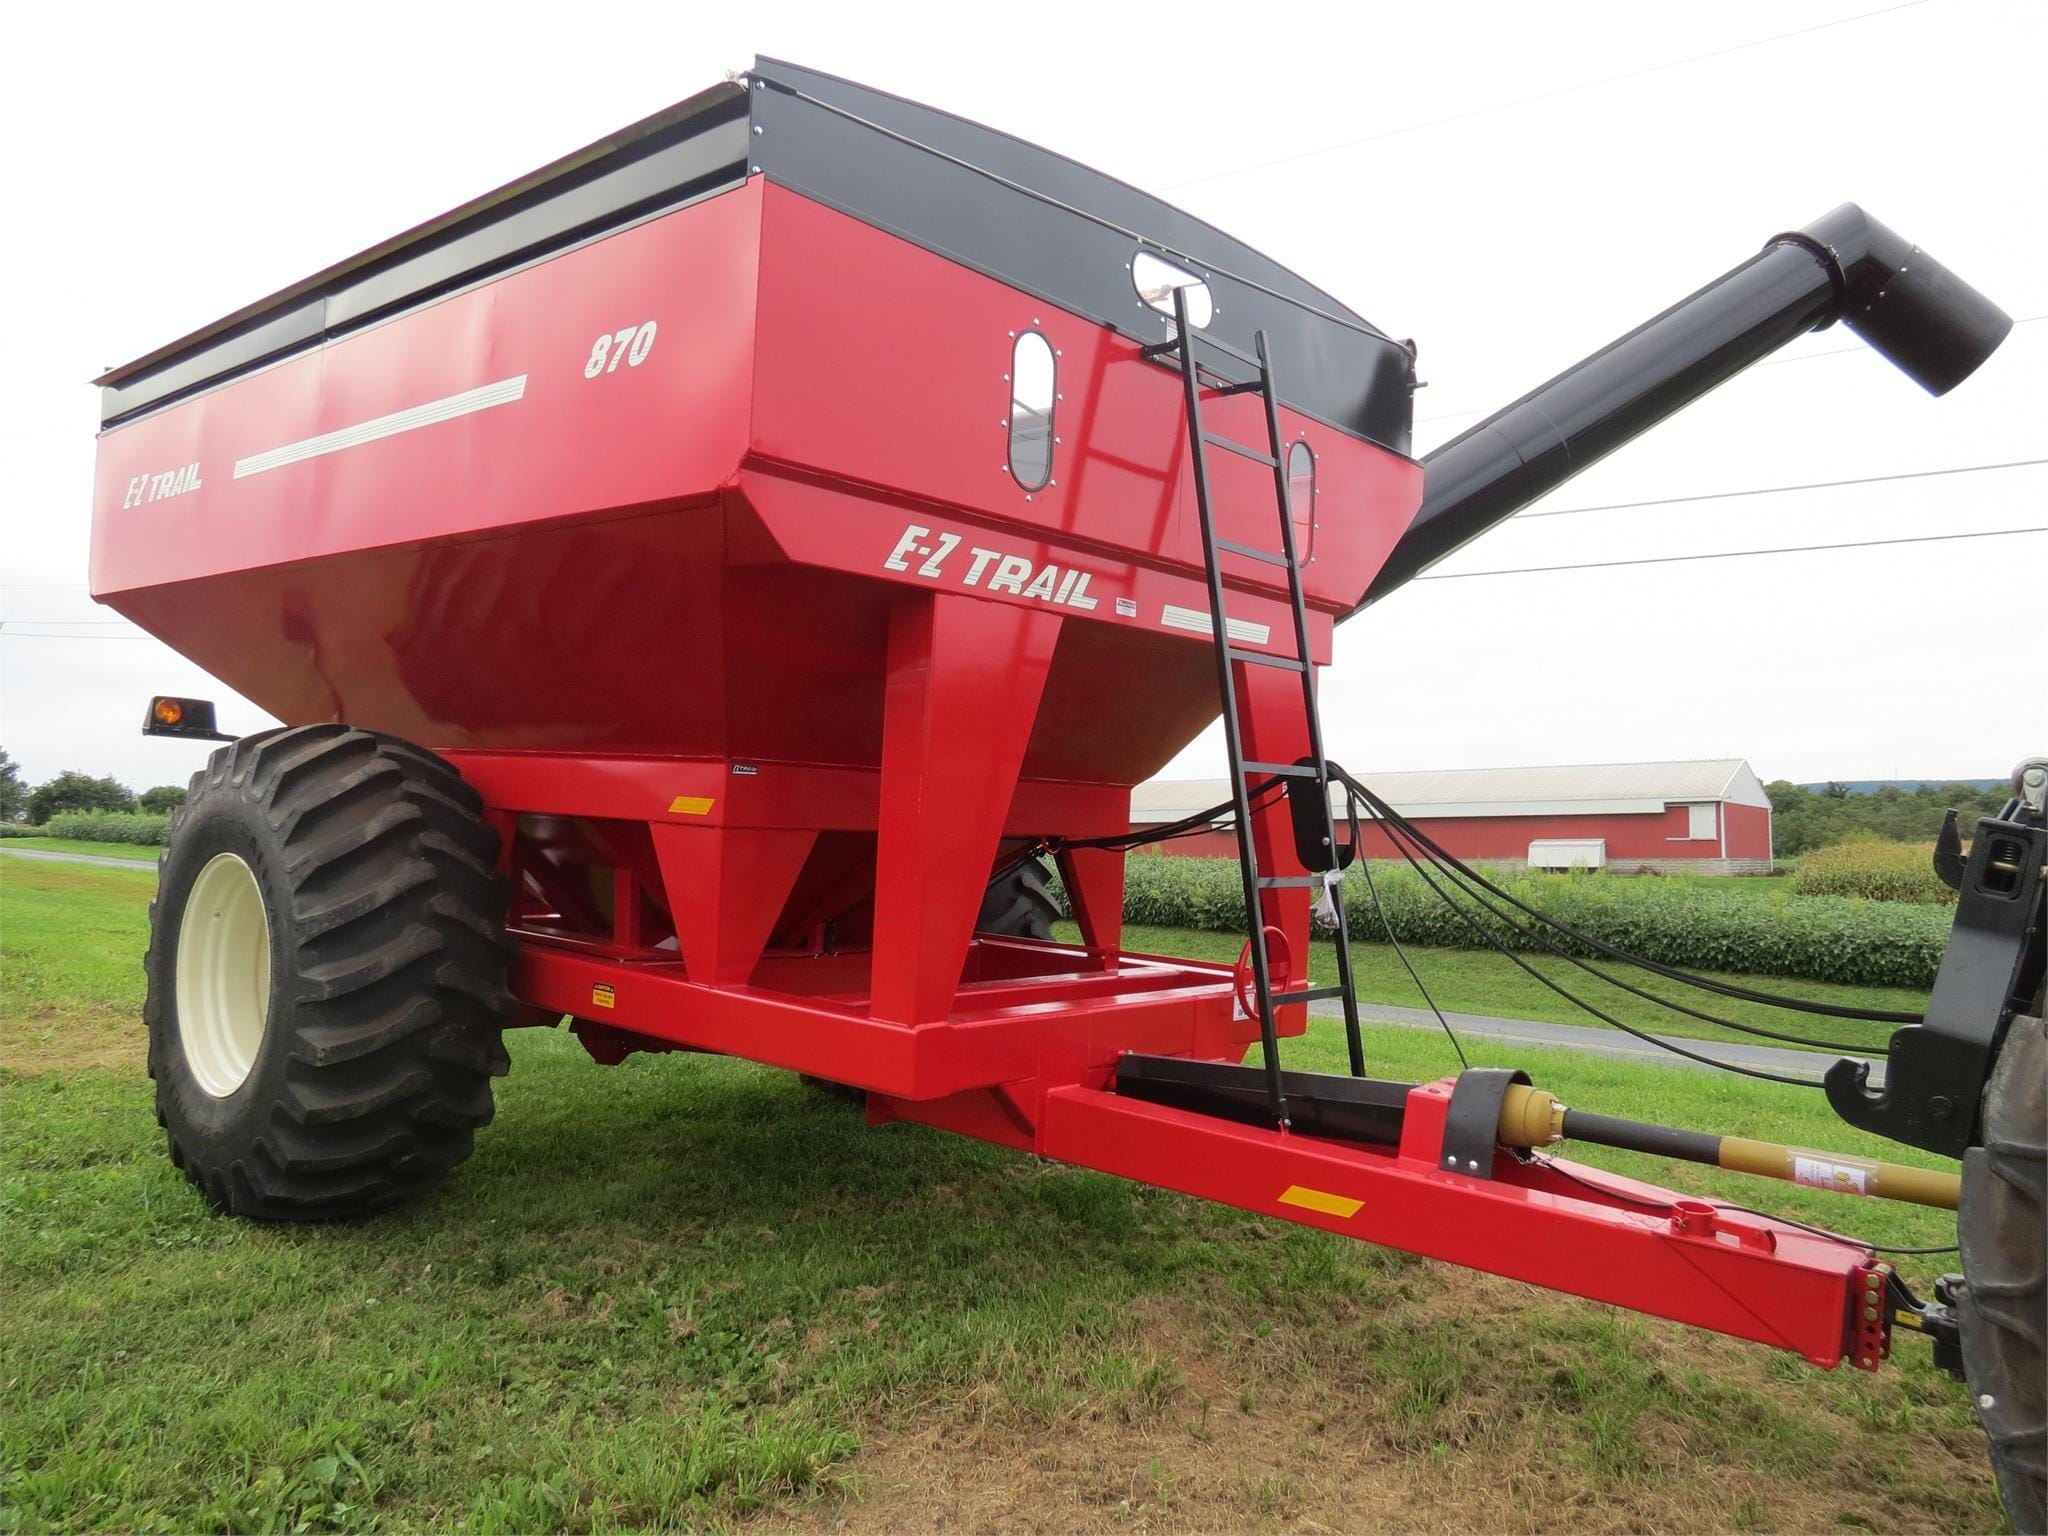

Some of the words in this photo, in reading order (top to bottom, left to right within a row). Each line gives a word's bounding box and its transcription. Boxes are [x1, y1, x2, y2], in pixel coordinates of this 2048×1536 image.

[583, 320, 658, 379] 870
[122, 473, 150, 509] E-Z
[147, 461, 203, 503] TRAIL
[883, 524, 962, 579] E-Z
[962, 546, 1099, 611] TRAIL
